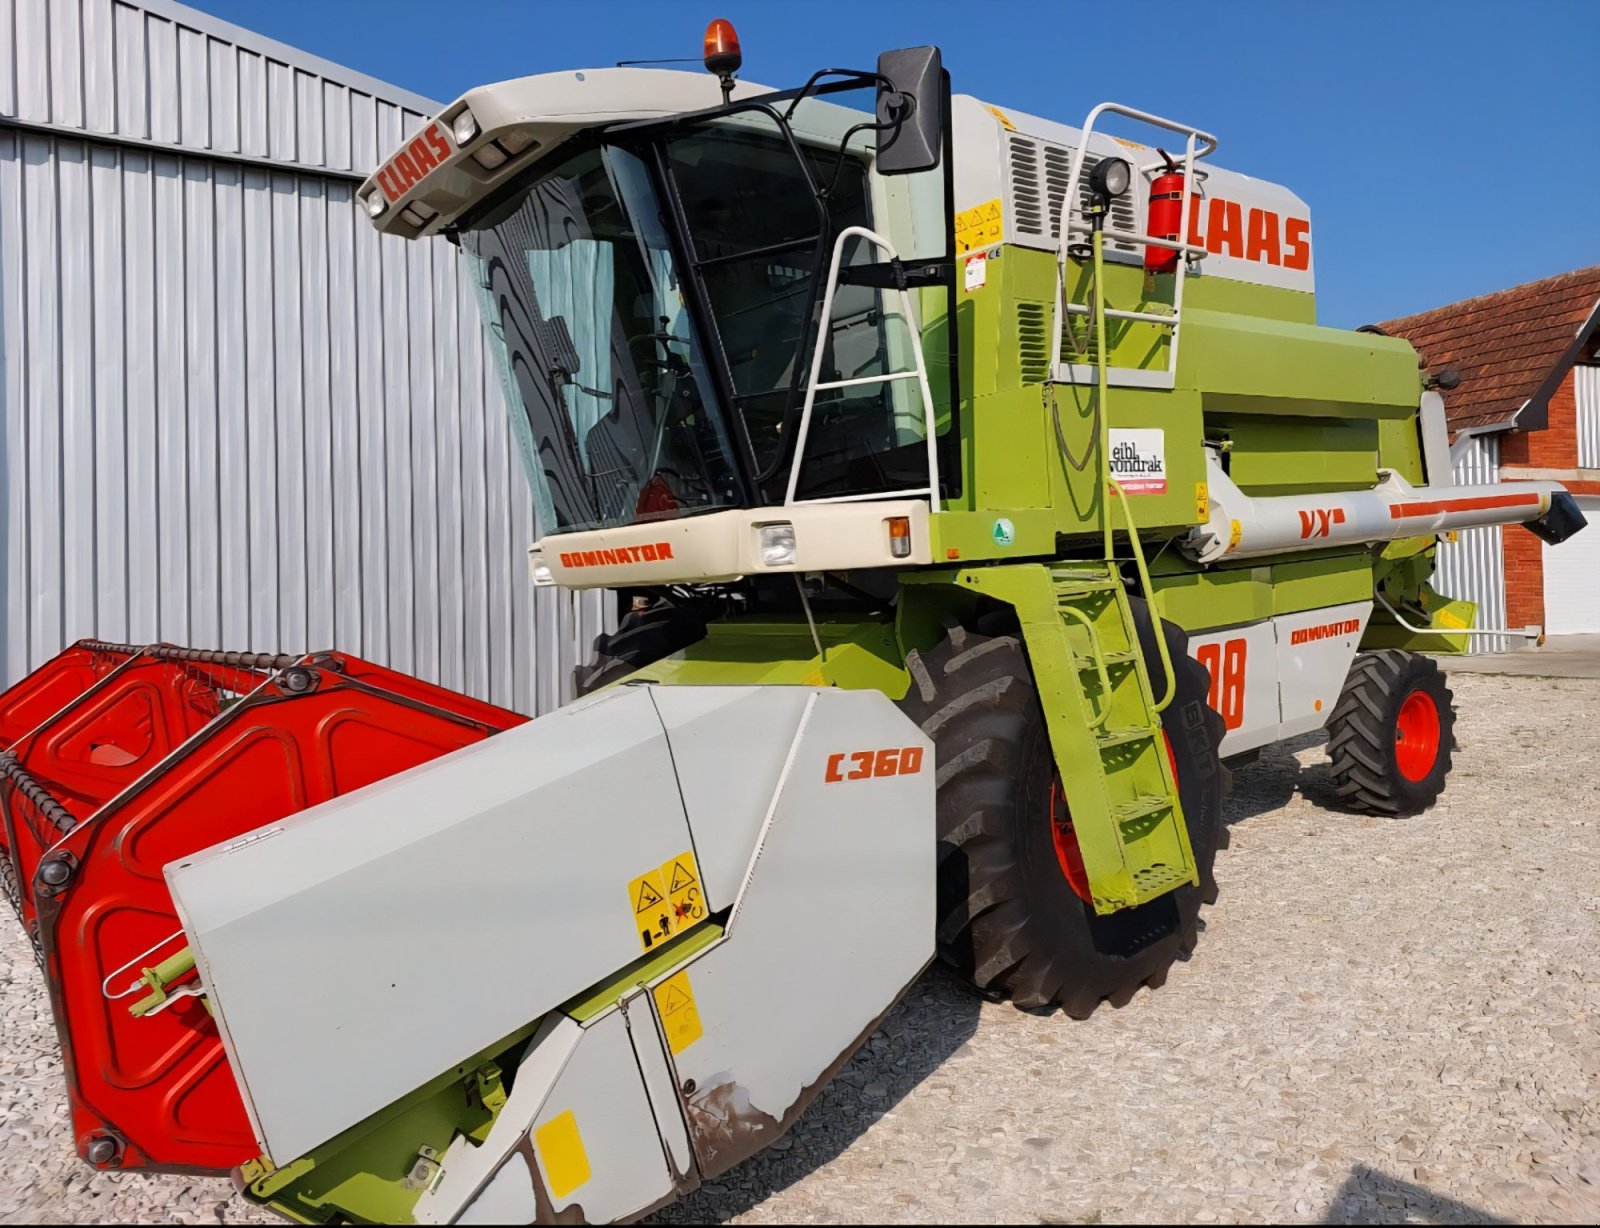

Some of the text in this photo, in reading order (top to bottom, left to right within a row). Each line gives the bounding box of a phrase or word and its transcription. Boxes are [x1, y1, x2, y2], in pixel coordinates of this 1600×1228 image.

[377, 123, 451, 202] CLAAS
[1187, 192, 1309, 271] LAAS
[1112, 442, 1138, 460] eibl
[560, 543, 674, 568] DOMINATOR
[1291, 619, 1360, 645] DOMINATOR
